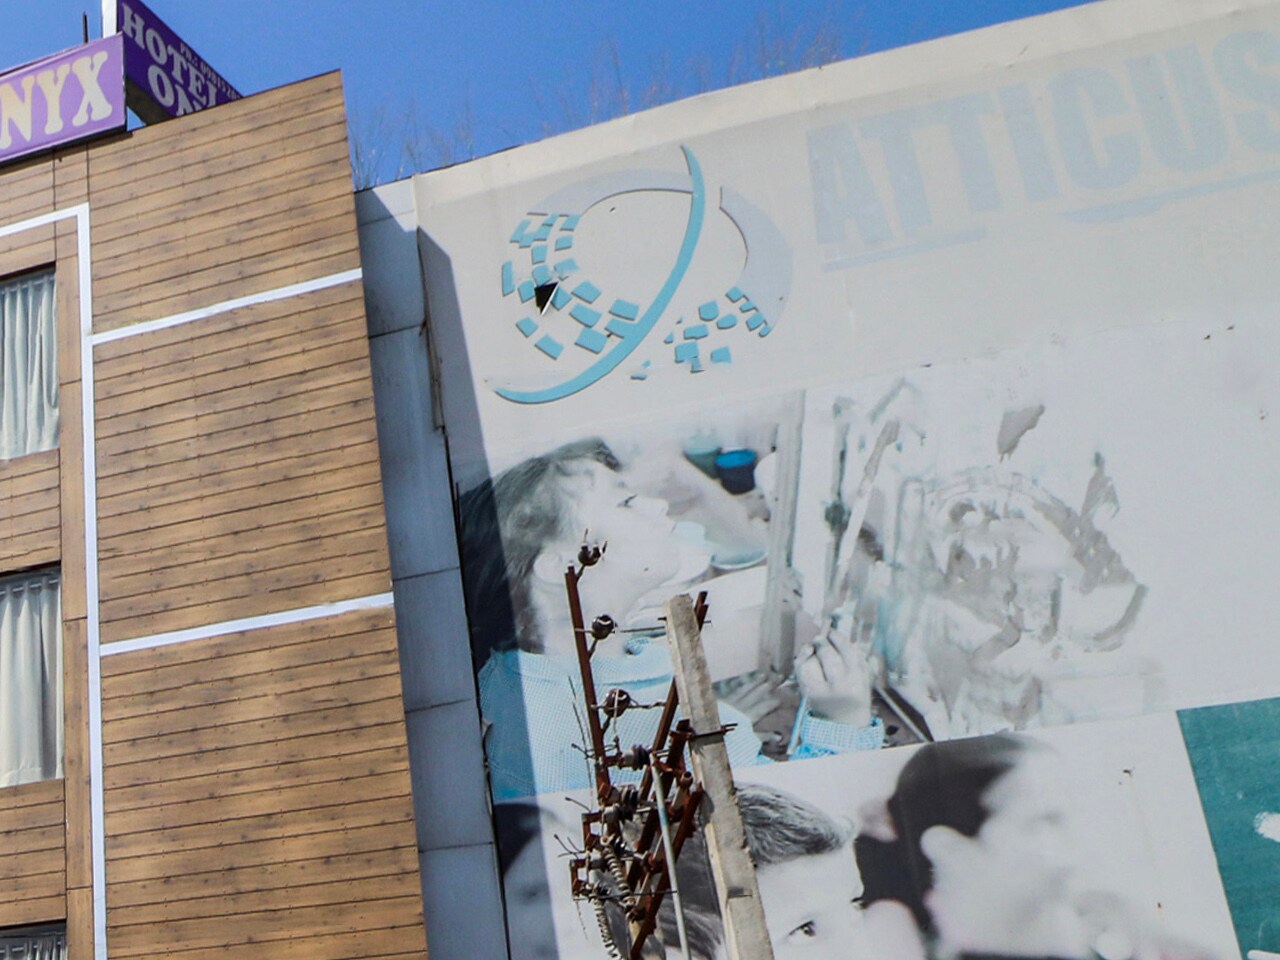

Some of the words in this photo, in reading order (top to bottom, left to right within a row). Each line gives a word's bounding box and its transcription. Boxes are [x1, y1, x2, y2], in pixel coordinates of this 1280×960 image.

[121, 2, 218, 109] HOTEL
[147, 65, 203, 116] ON
[806, 29, 1280, 246] ATTICUS
